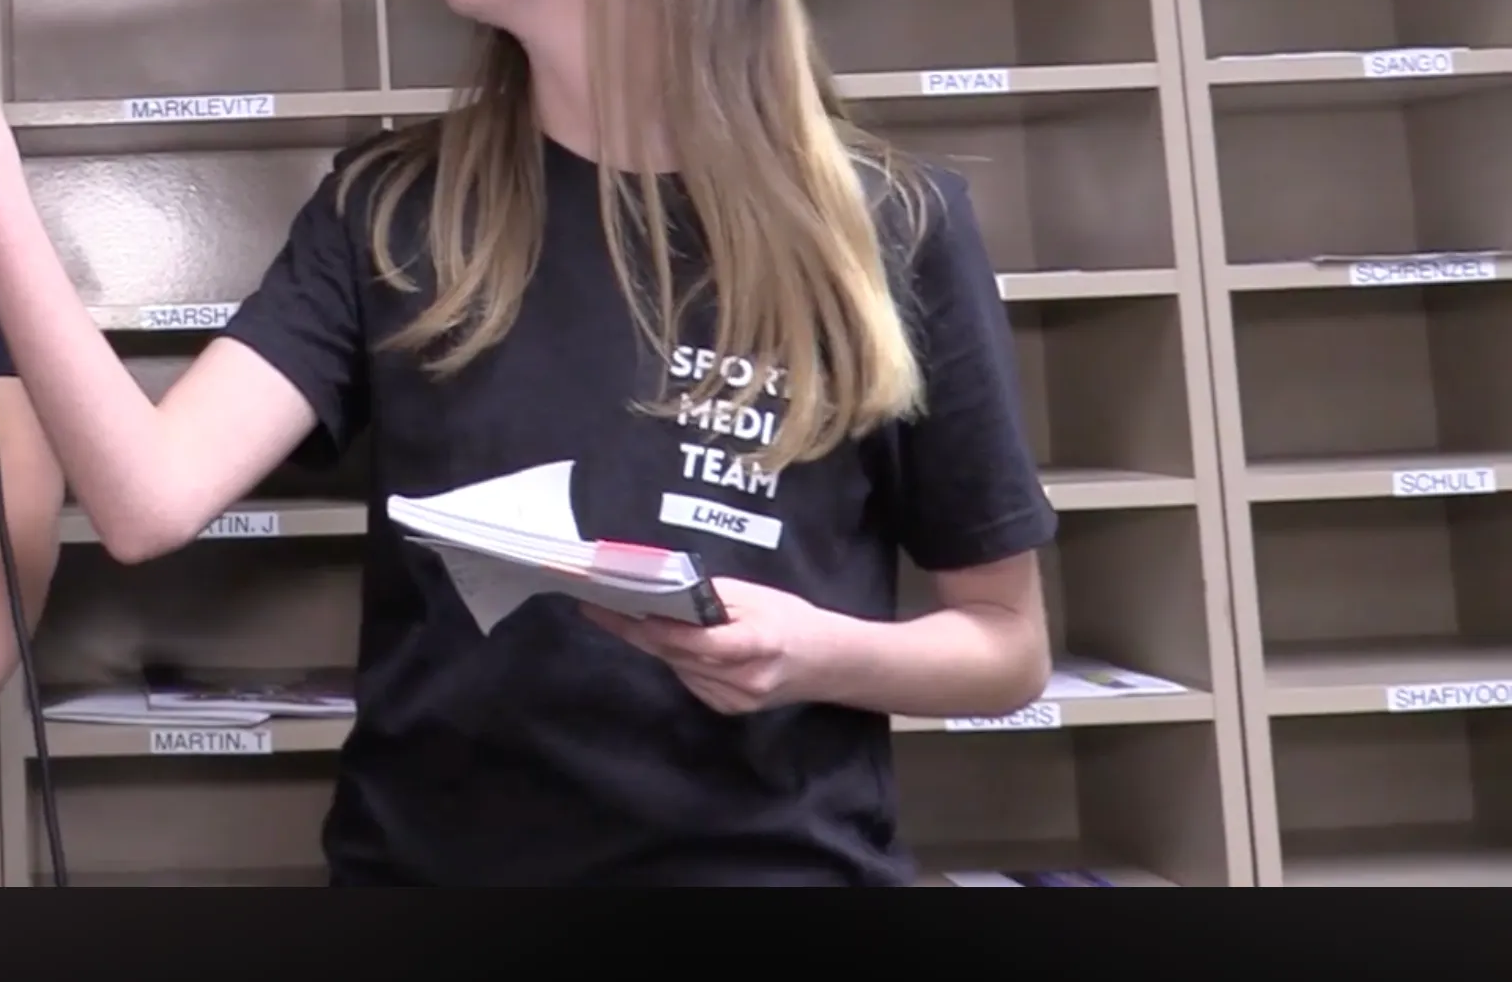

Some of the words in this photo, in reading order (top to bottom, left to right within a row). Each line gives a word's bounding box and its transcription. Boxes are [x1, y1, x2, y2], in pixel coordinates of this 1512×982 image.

[1371, 53, 1449, 75] SANGO
[928, 73, 1004, 91] PAYAN
[130, 97, 272, 119] MARKLEVITZ
[1356, 259, 1492, 282] SCHRENZEL
[146, 306, 230, 326] MARSH
[677, 392, 776, 446] MEDI
[679, 442, 780, 499] TEAM
[1400, 471, 1488, 493] SCHULT
[208, 516, 256, 535] TIN.
[261, 515, 275, 535] J
[692, 505, 750, 534] LHHS
[1395, 683, 1512, 709] SHAFIYOO
[252, 731, 268, 751] T
